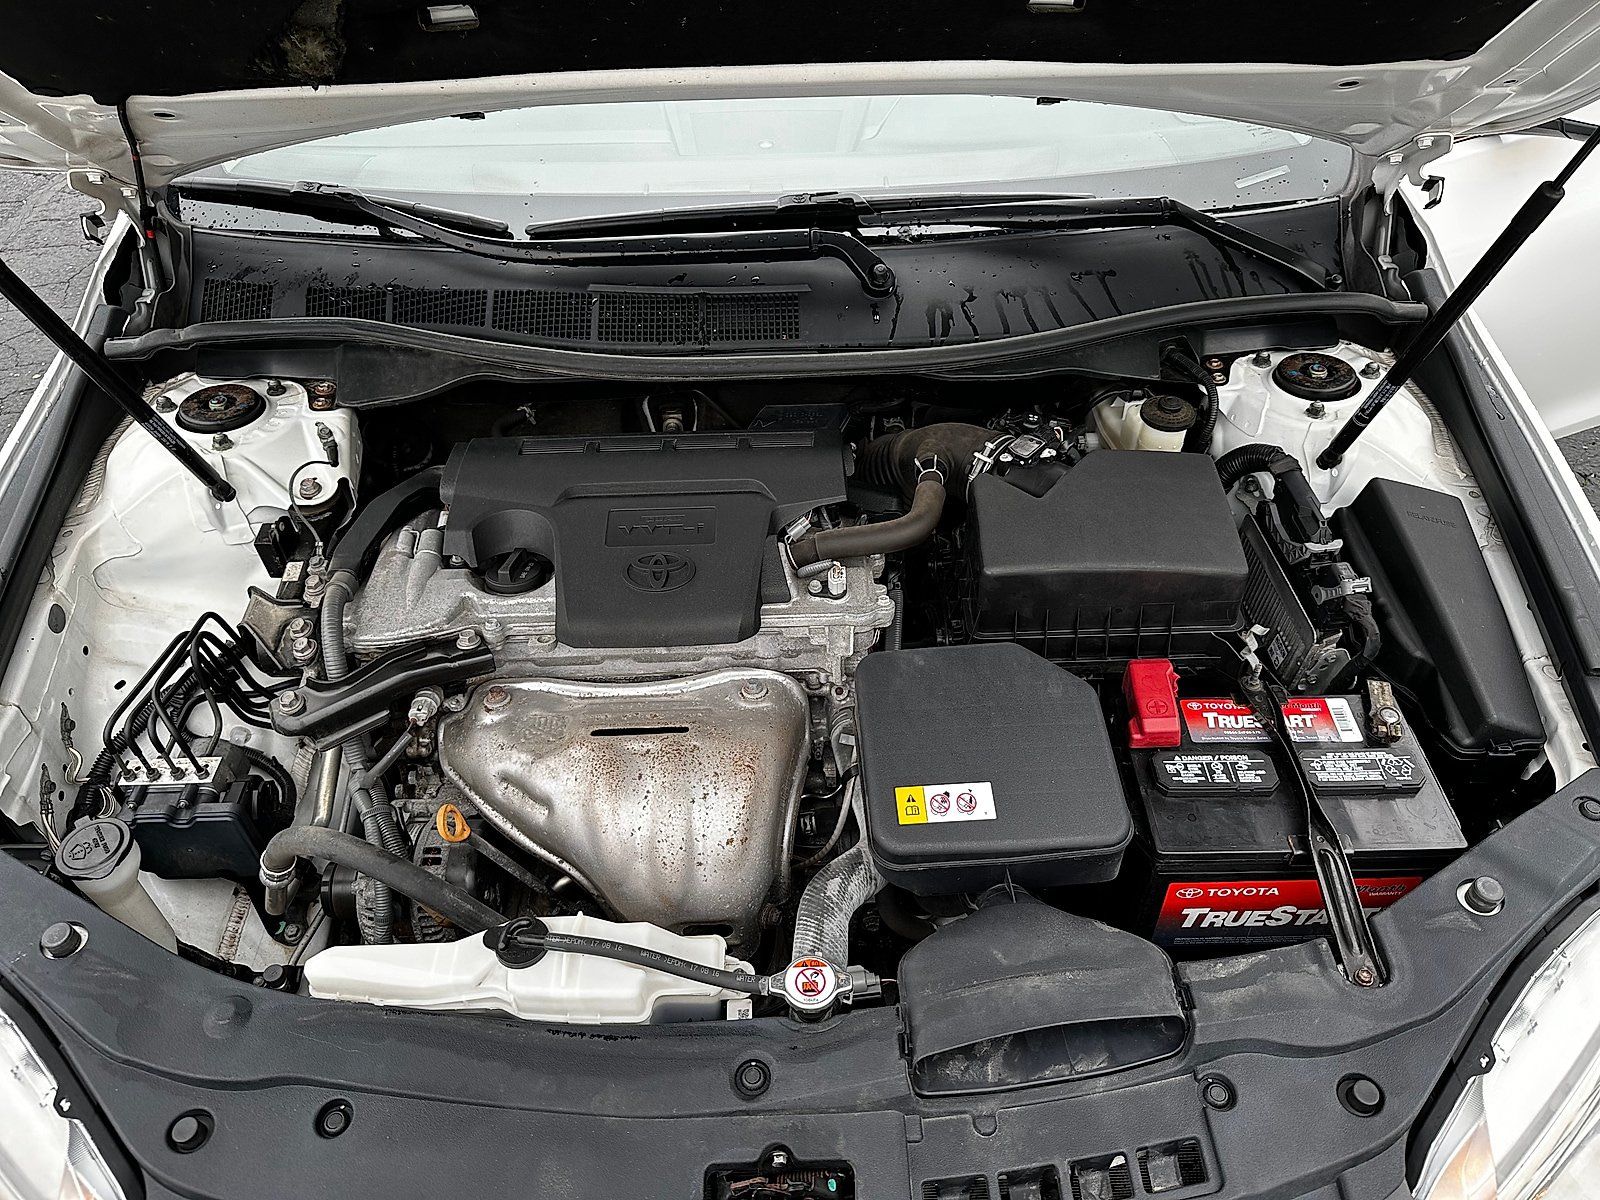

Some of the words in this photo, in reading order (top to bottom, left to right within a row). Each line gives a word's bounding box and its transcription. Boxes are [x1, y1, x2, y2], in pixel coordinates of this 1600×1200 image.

[1207, 887, 1280, 898] TOYOTA
[590, 940, 600, 949] 17
[640, 950, 662, 961] WATER
[689, 964, 698, 972] 17
[736, 974, 756, 983] WATER
